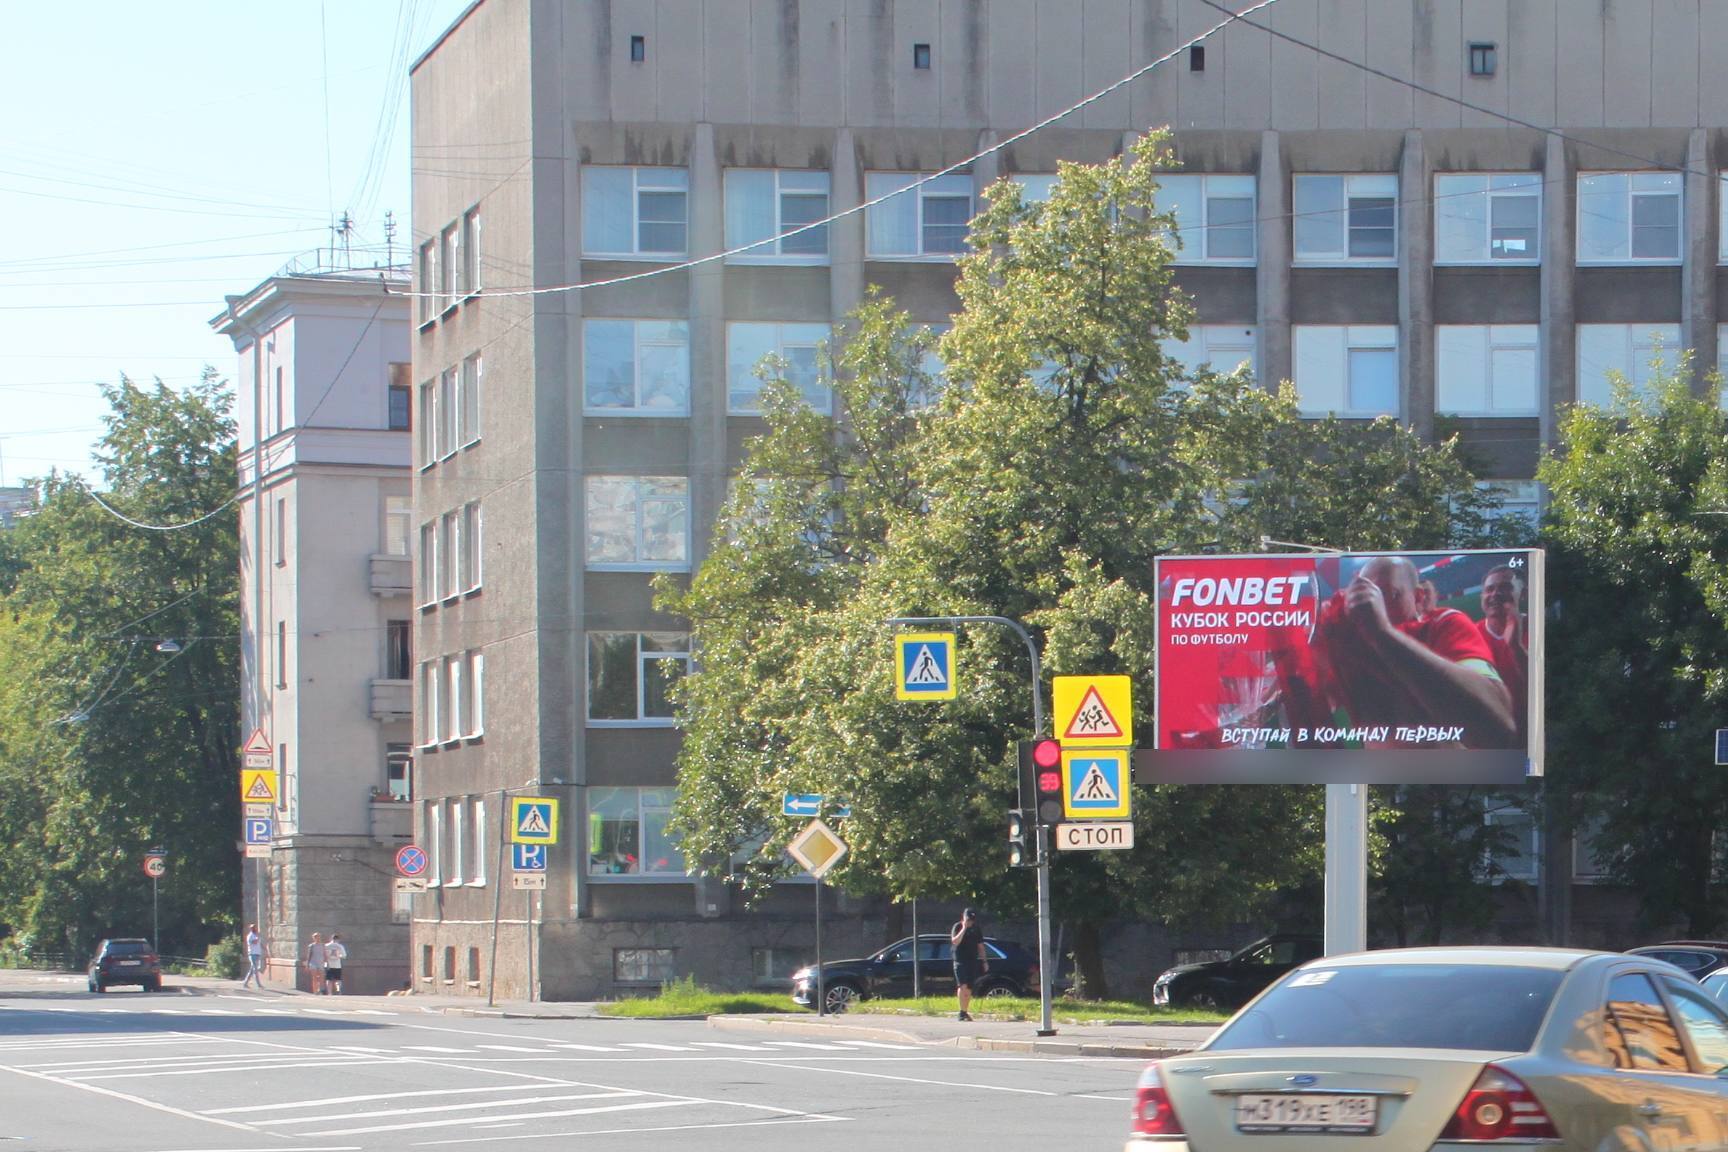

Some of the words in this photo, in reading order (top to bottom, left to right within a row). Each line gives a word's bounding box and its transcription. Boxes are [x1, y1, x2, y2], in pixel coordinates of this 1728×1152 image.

[1509, 556, 1524, 568] 6+
[1171, 576, 1309, 607] FONBET
[1171, 612, 1230, 628] КУБОК
[1235, 611, 1310, 627] РОССИИ
[1171, 634, 1188, 645] ПО
[1190, 633, 1249, 645] ФУТБОЛУ
[1221, 727, 1291, 744] ВСТУПАЙ
[1297, 727, 1308, 742] В
[1314, 726, 1389, 743] КОМАНДУ
[1395, 725, 1464, 743] ПЕРВЫХ
[1069, 827, 1123, 845] СТОП
